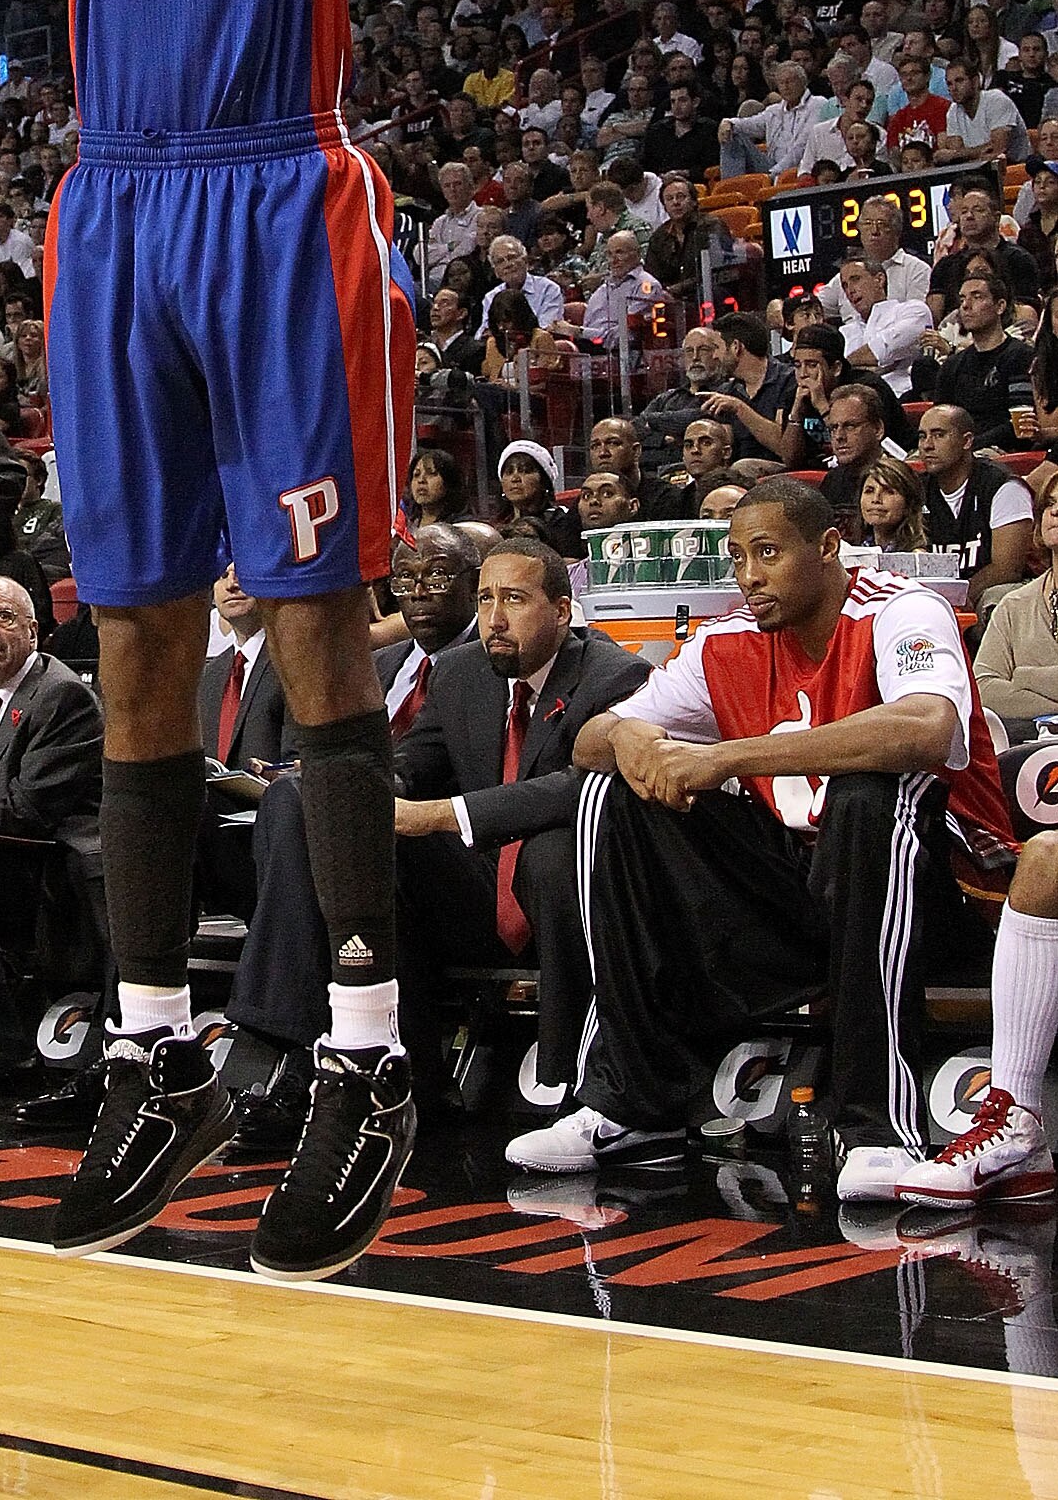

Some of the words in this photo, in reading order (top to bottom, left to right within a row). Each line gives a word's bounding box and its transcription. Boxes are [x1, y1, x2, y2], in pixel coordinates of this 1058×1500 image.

[782, 257, 812, 275] HEAT
[278, 476, 339, 563] P
[905, 650, 934, 665] NBA
